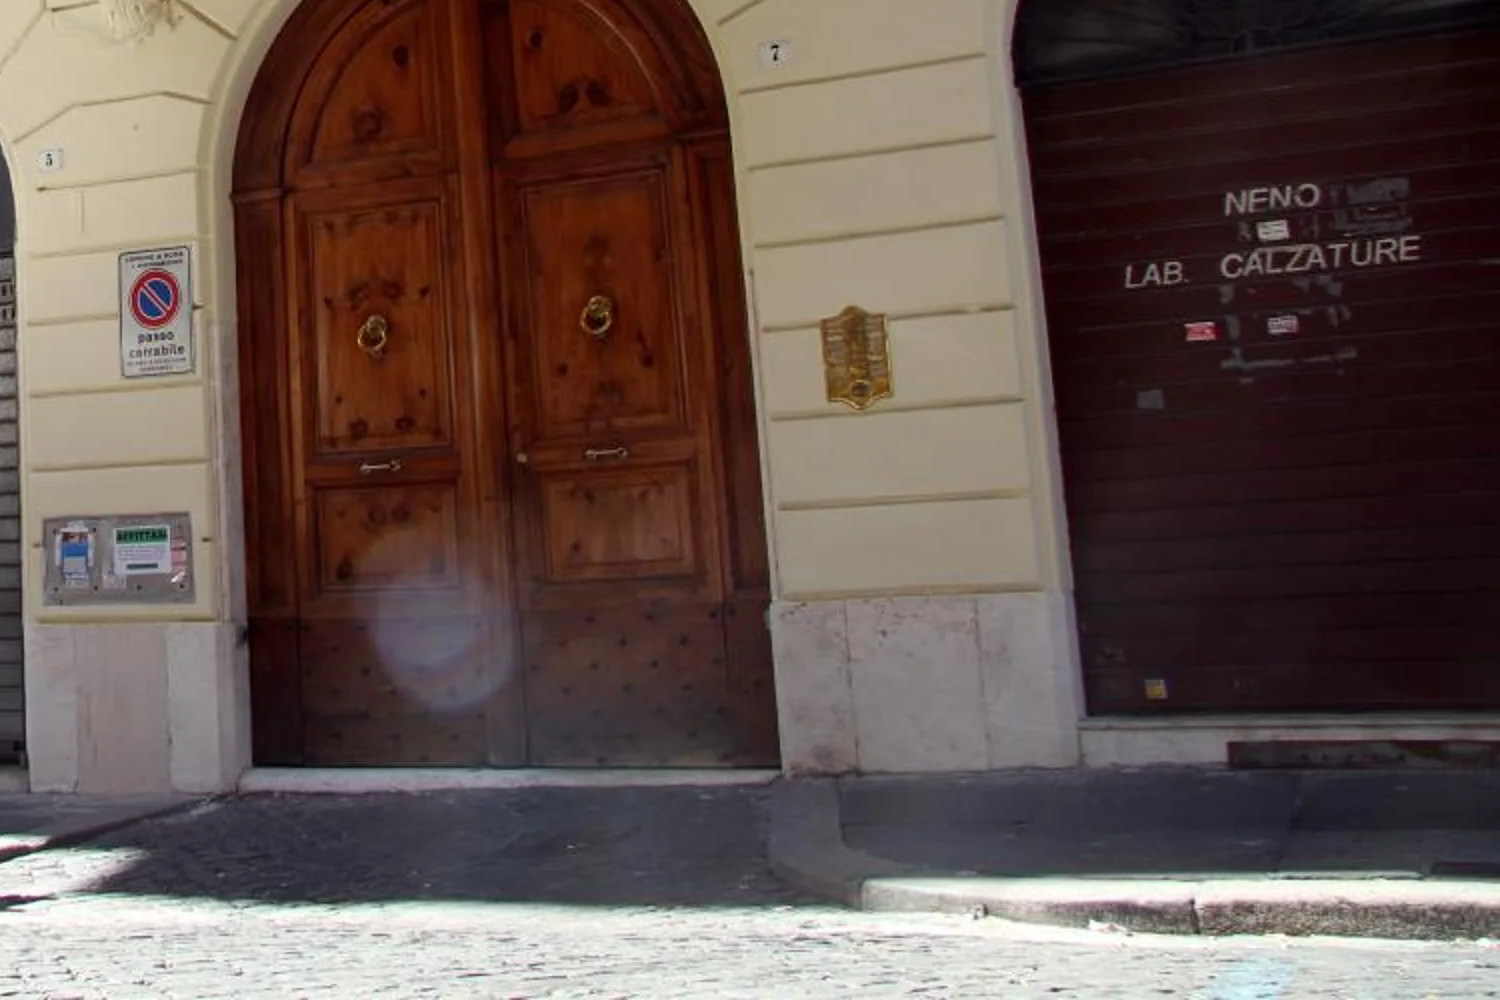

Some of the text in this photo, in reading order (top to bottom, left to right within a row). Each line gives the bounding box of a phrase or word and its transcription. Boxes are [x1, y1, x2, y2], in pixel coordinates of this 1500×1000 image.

[771, 44, 780, 61] 7
[1224, 183, 1321, 217] NENO
[1124, 235, 1422, 289] LAB. CALZATURE
[137, 331, 175, 344] passo
[128, 343, 185, 359] carrabile
